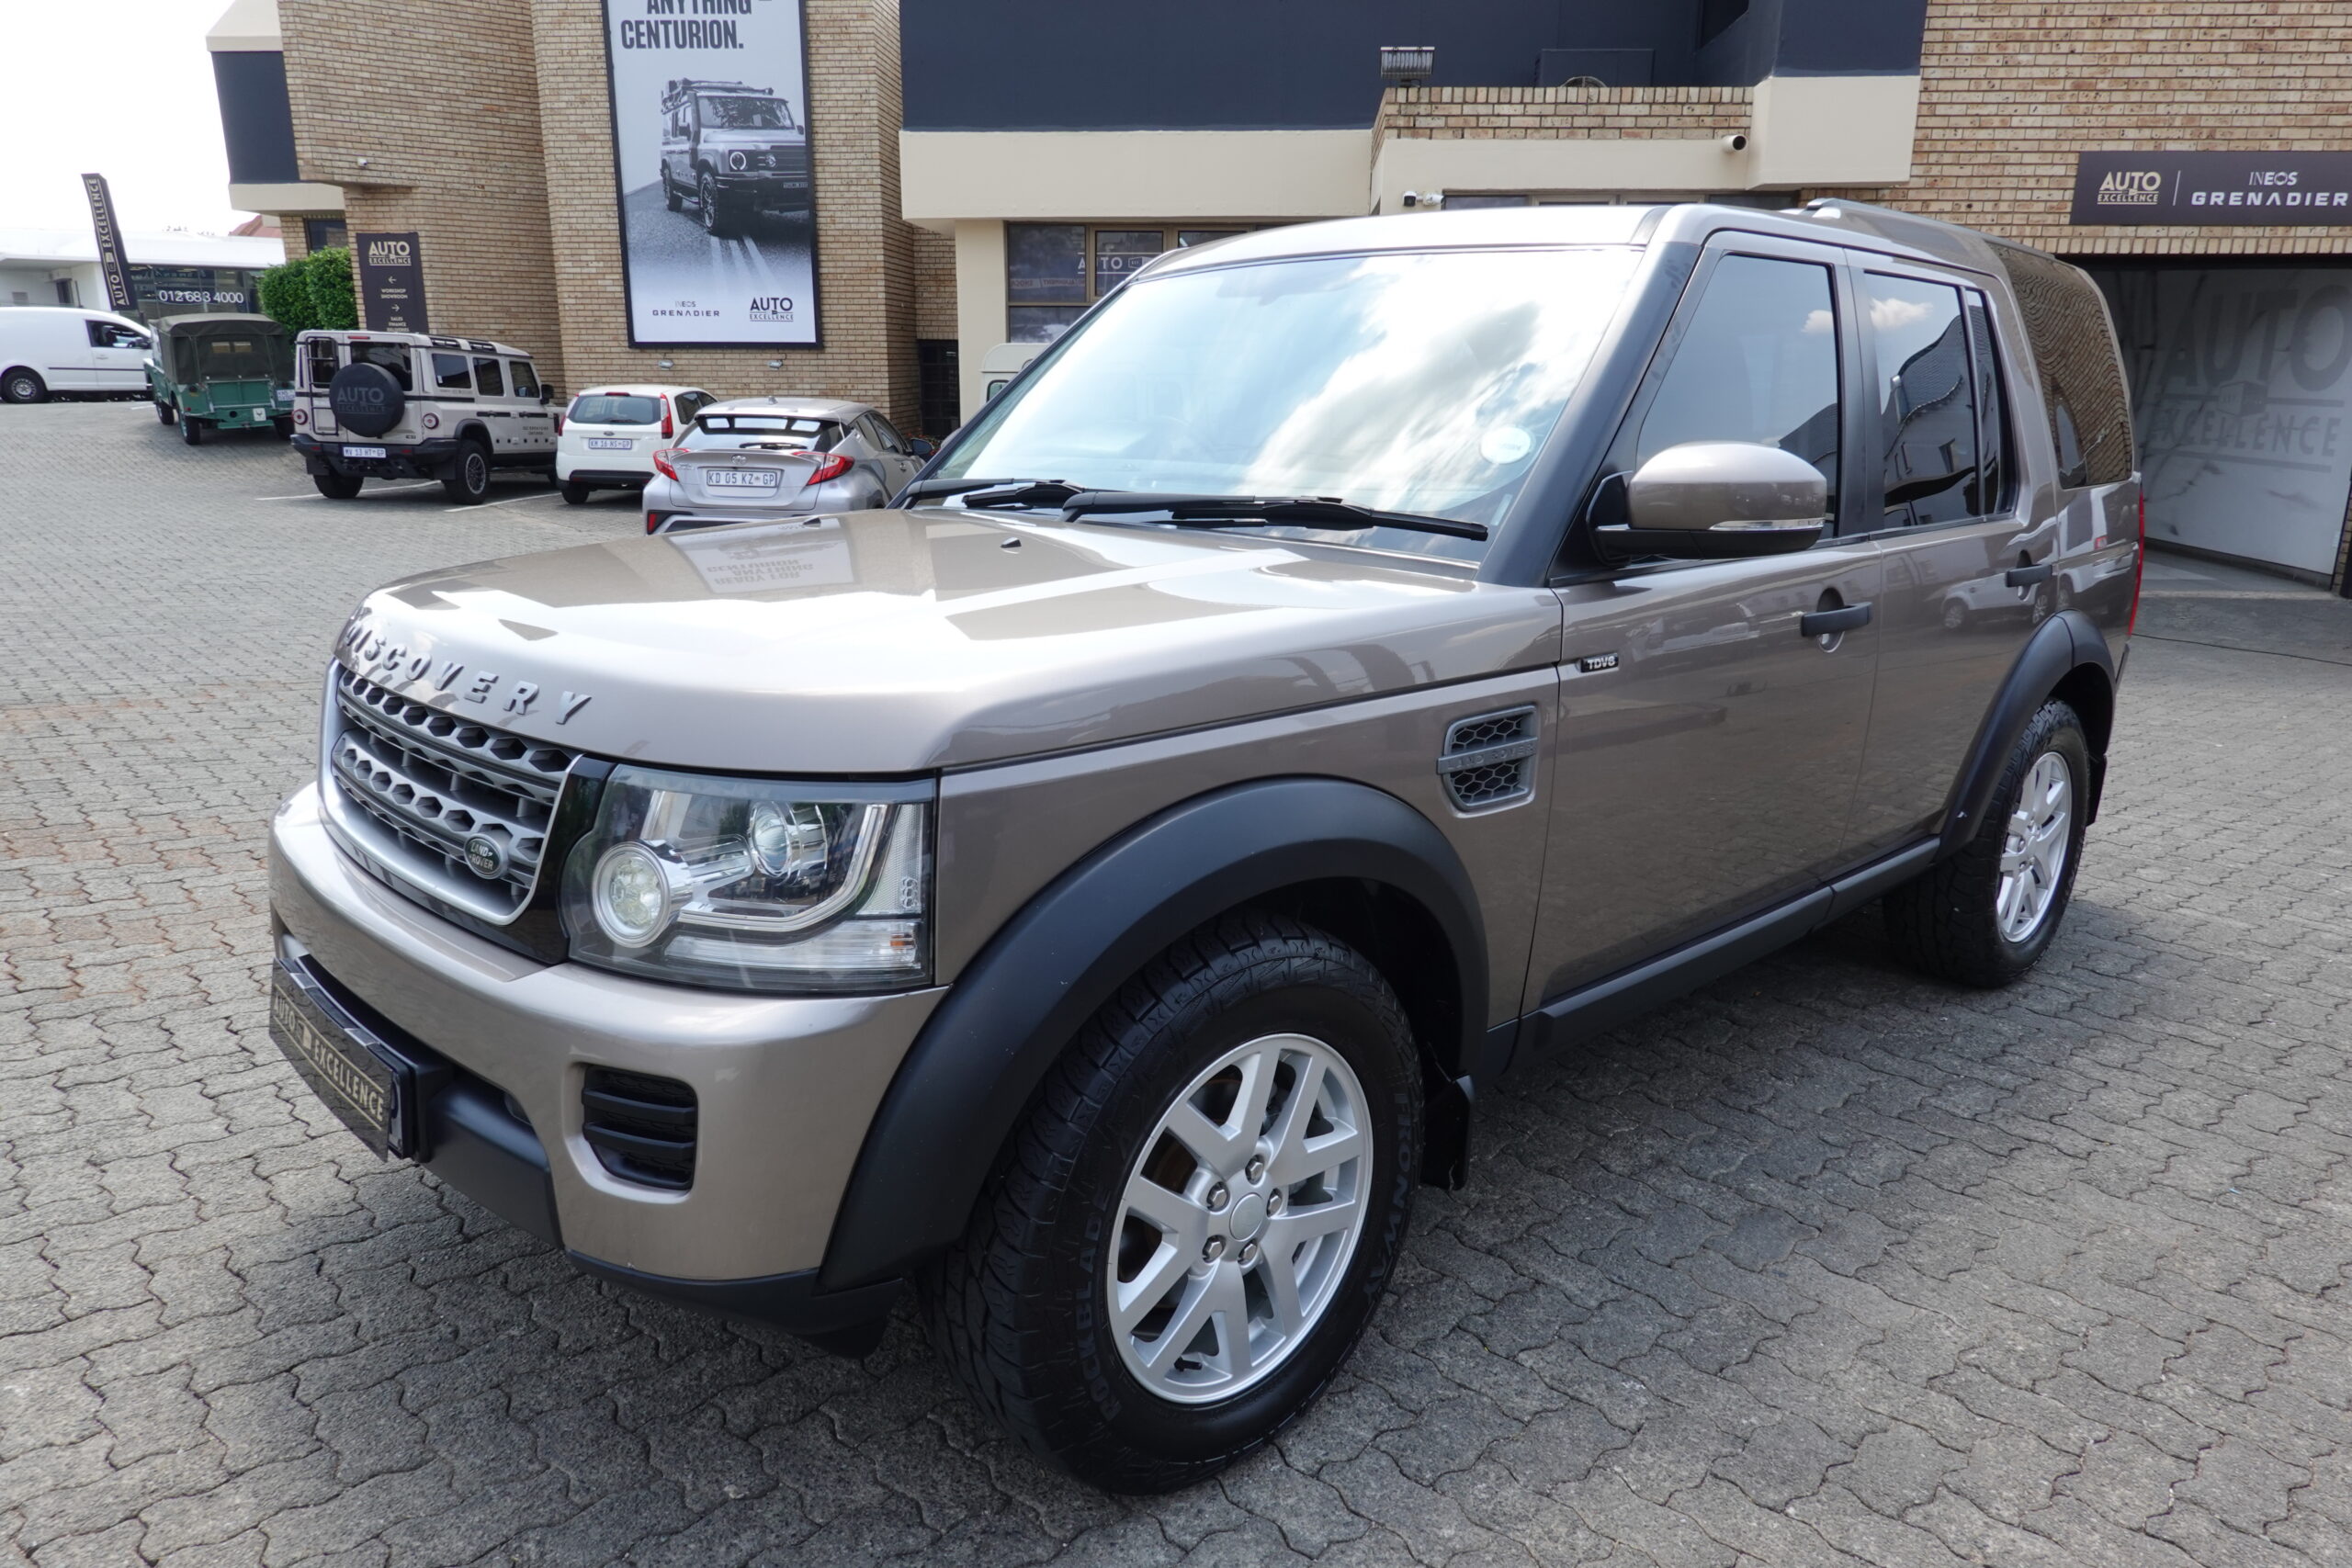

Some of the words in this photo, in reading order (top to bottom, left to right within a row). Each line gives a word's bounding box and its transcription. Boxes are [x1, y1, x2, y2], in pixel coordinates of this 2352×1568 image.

[620, 19, 744, 50] CENTURION.
[2098, 171, 2162, 191] AUTO
[2248, 171, 2299, 186] INEOS
[2097, 193, 2159, 202] EXCELLENCE
[2190, 191, 2349, 207] GRENADIER
[88, 178, 112, 248] EXCELLENCE
[368, 241, 411, 256] AUTO
[1077, 256, 1123, 270] ATO
[109, 275, 127, 306] AUTO
[158, 289, 184, 302] 012
[185, 290, 211, 303] 683
[213, 292, 244, 304] 4000
[750, 297, 794, 311] AUTO
[2158, 285, 2352, 392] AUTO
[337, 387, 384, 403] AUTO
[708, 472, 720, 484] KD
[741, 473, 753, 485] KZ
[763, 474, 775, 485] GP
[345, 620, 593, 726] DISCOVERY
[470, 841, 489, 857] LAND
[471, 854, 493, 871] ROVER
[313, 1039, 384, 1122] EXCELLENCE
